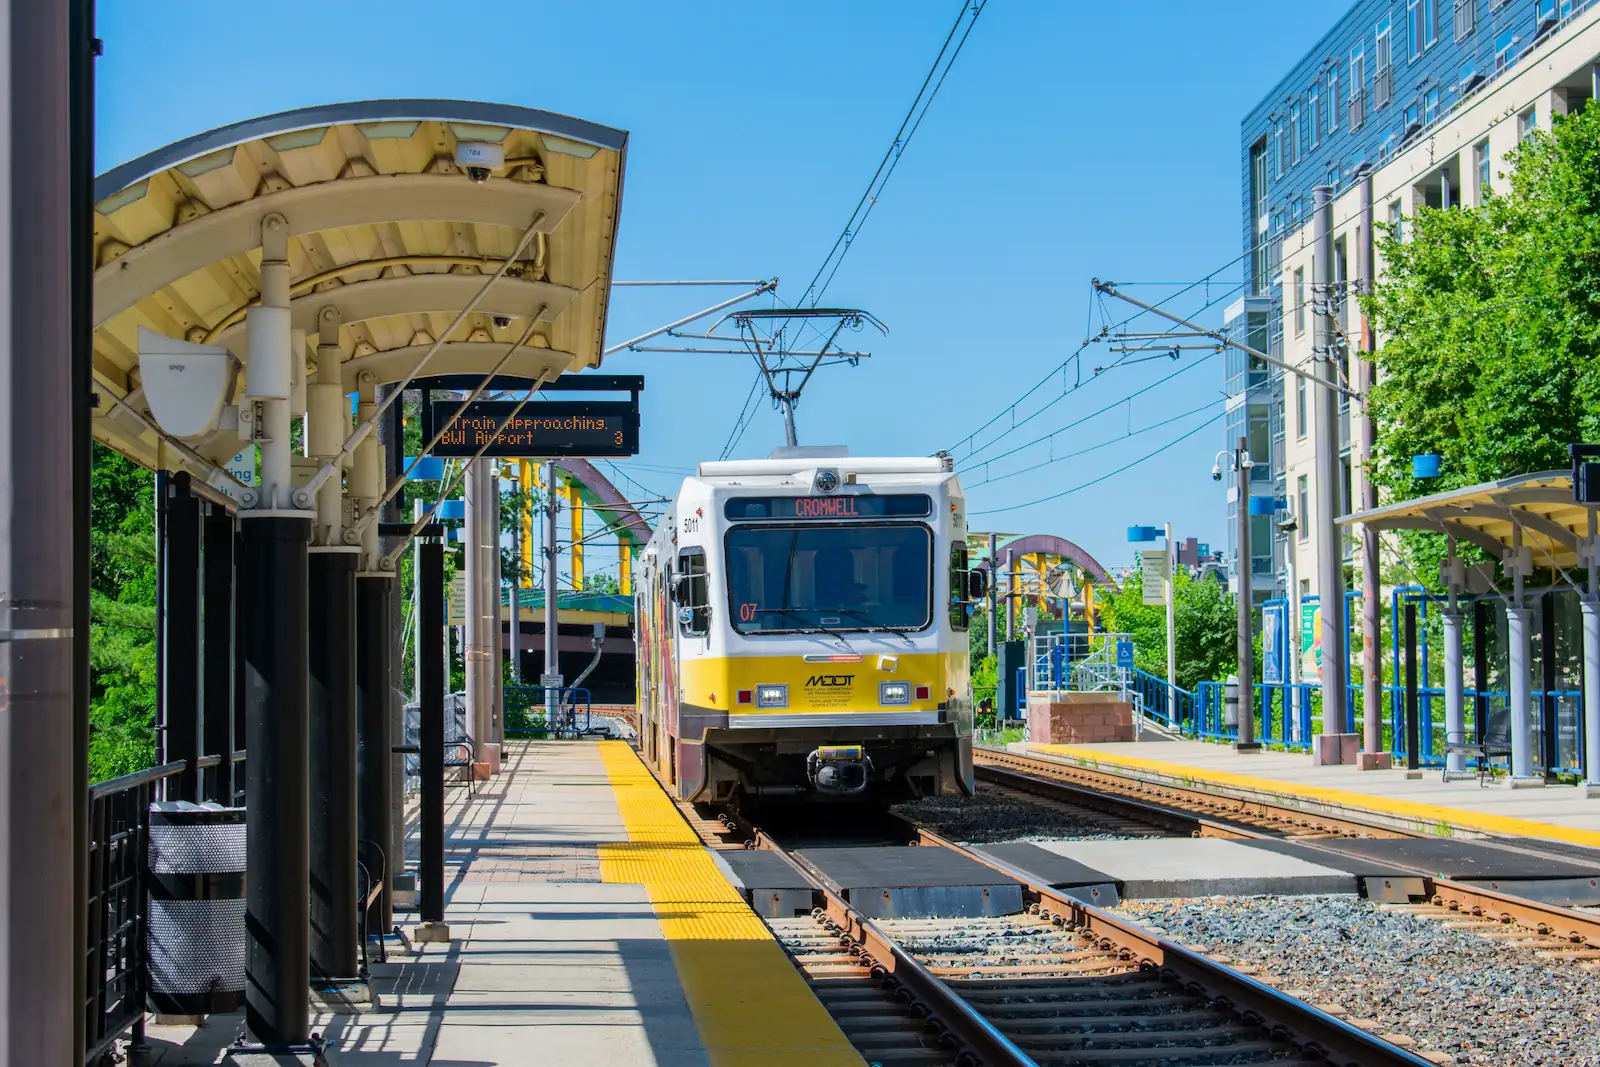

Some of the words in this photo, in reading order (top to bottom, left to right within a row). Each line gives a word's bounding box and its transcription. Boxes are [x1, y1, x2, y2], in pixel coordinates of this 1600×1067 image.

[450, 415, 496, 430] Train
[441, 430, 466, 445] BWI
[475, 430, 533, 445] Airport
[614, 430, 623, 445] 3
[795, 498, 859, 517] CROMWELL
[684, 518, 699, 533] 5011
[740, 603, 758, 621] 07
[805, 675, 855, 686] MDOT
